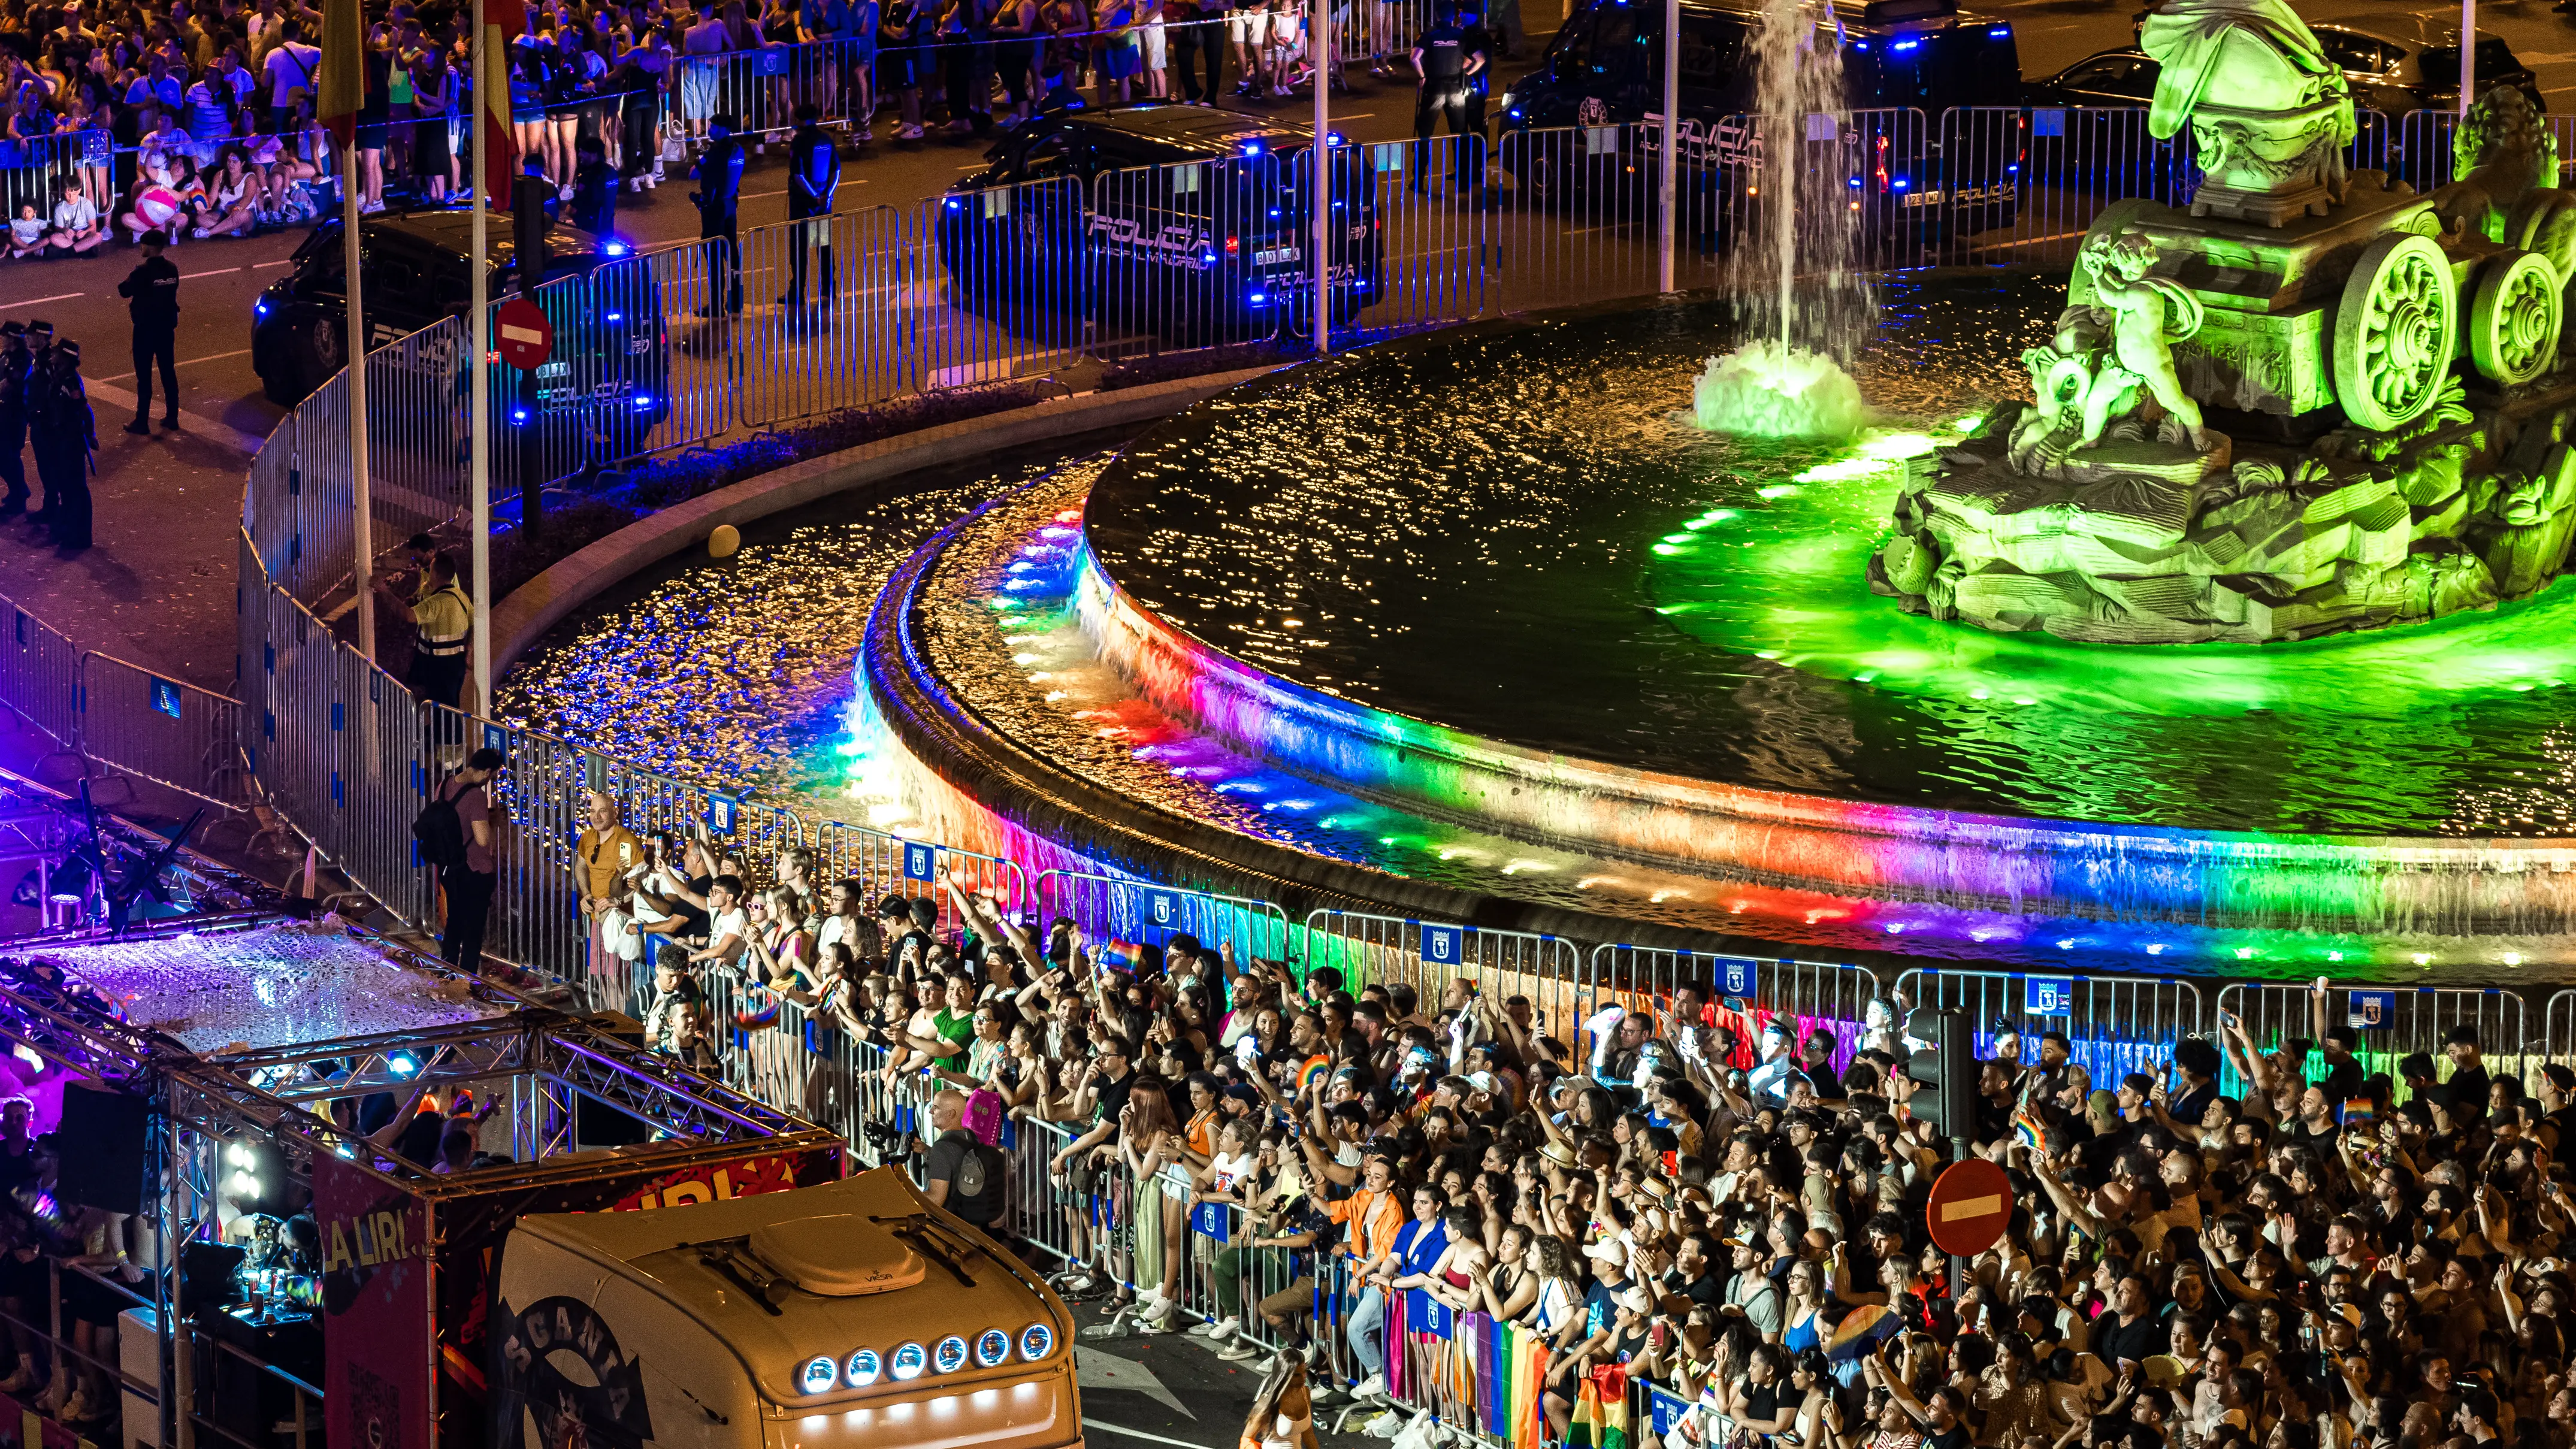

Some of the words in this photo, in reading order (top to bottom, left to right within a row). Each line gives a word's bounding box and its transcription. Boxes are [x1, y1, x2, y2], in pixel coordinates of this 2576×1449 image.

[1221, 128, 1291, 141] 4920
[1087, 215, 1212, 254] POLICÍA
[864, 1273, 893, 1282] VIESA
